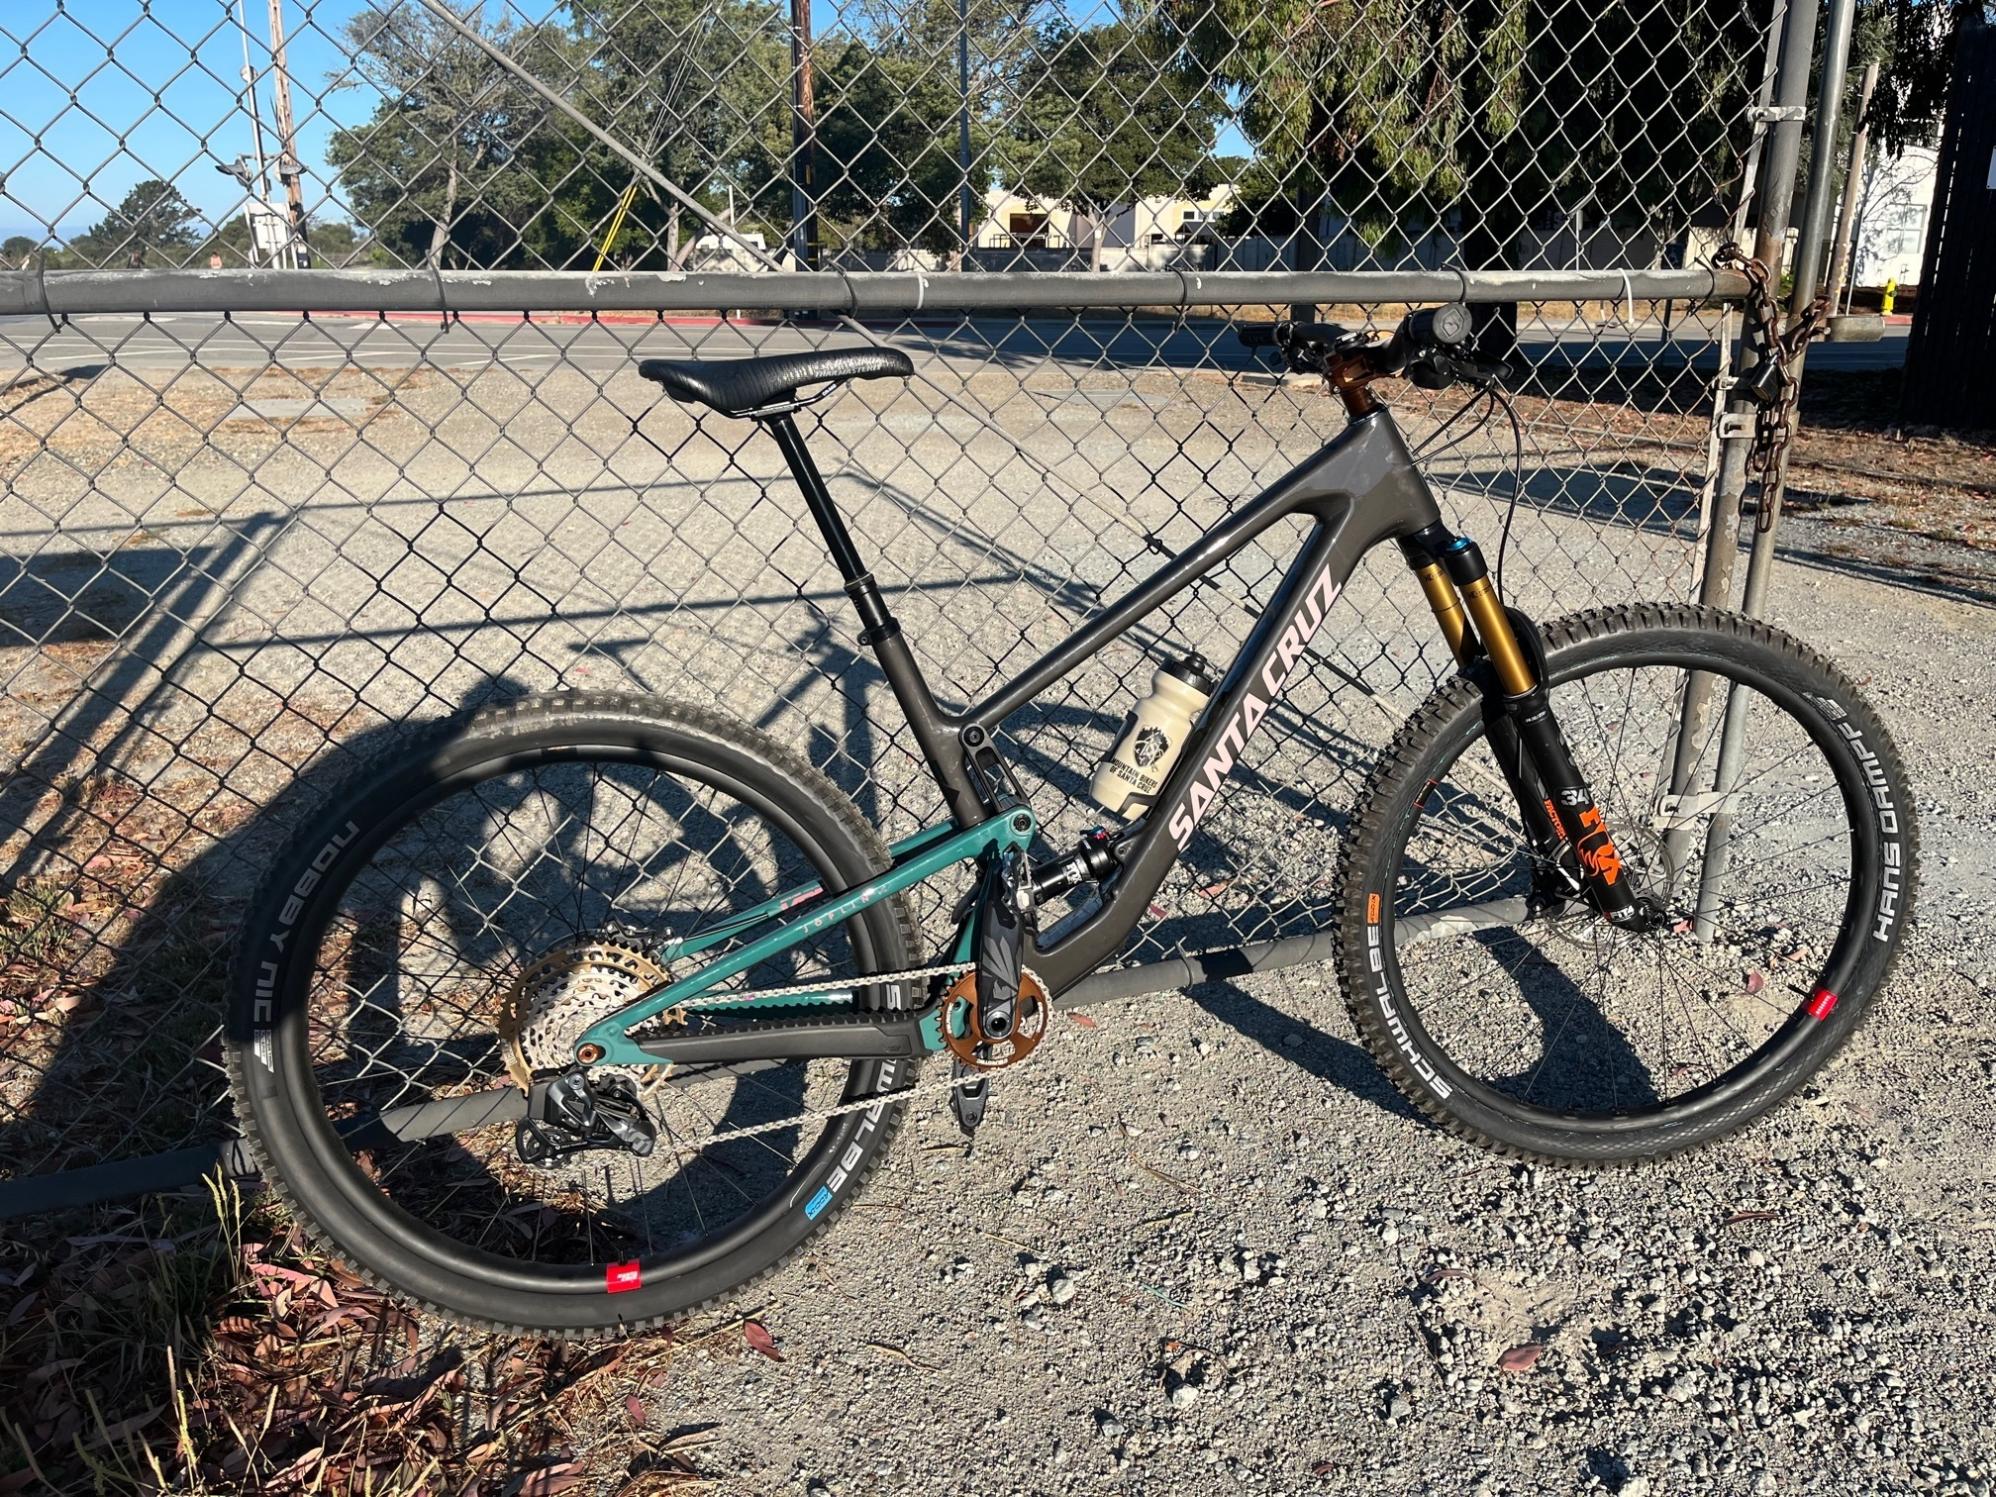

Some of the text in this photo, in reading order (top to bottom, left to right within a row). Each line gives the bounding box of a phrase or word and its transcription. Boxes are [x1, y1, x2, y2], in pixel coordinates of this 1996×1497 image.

[1117, 770, 1137, 786] SANTA
[1137, 781, 1152, 793] CRUZ
[1168, 564, 1342, 850] SANTA CRUZ
[1560, 789, 1589, 806] 34
[1578, 806, 1622, 886] FOX
[1837, 721, 1900, 942] HANS DAMPF
[254, 820, 360, 1024] NOBBY NIC
[1366, 926, 1453, 1099] SCHWALBE
